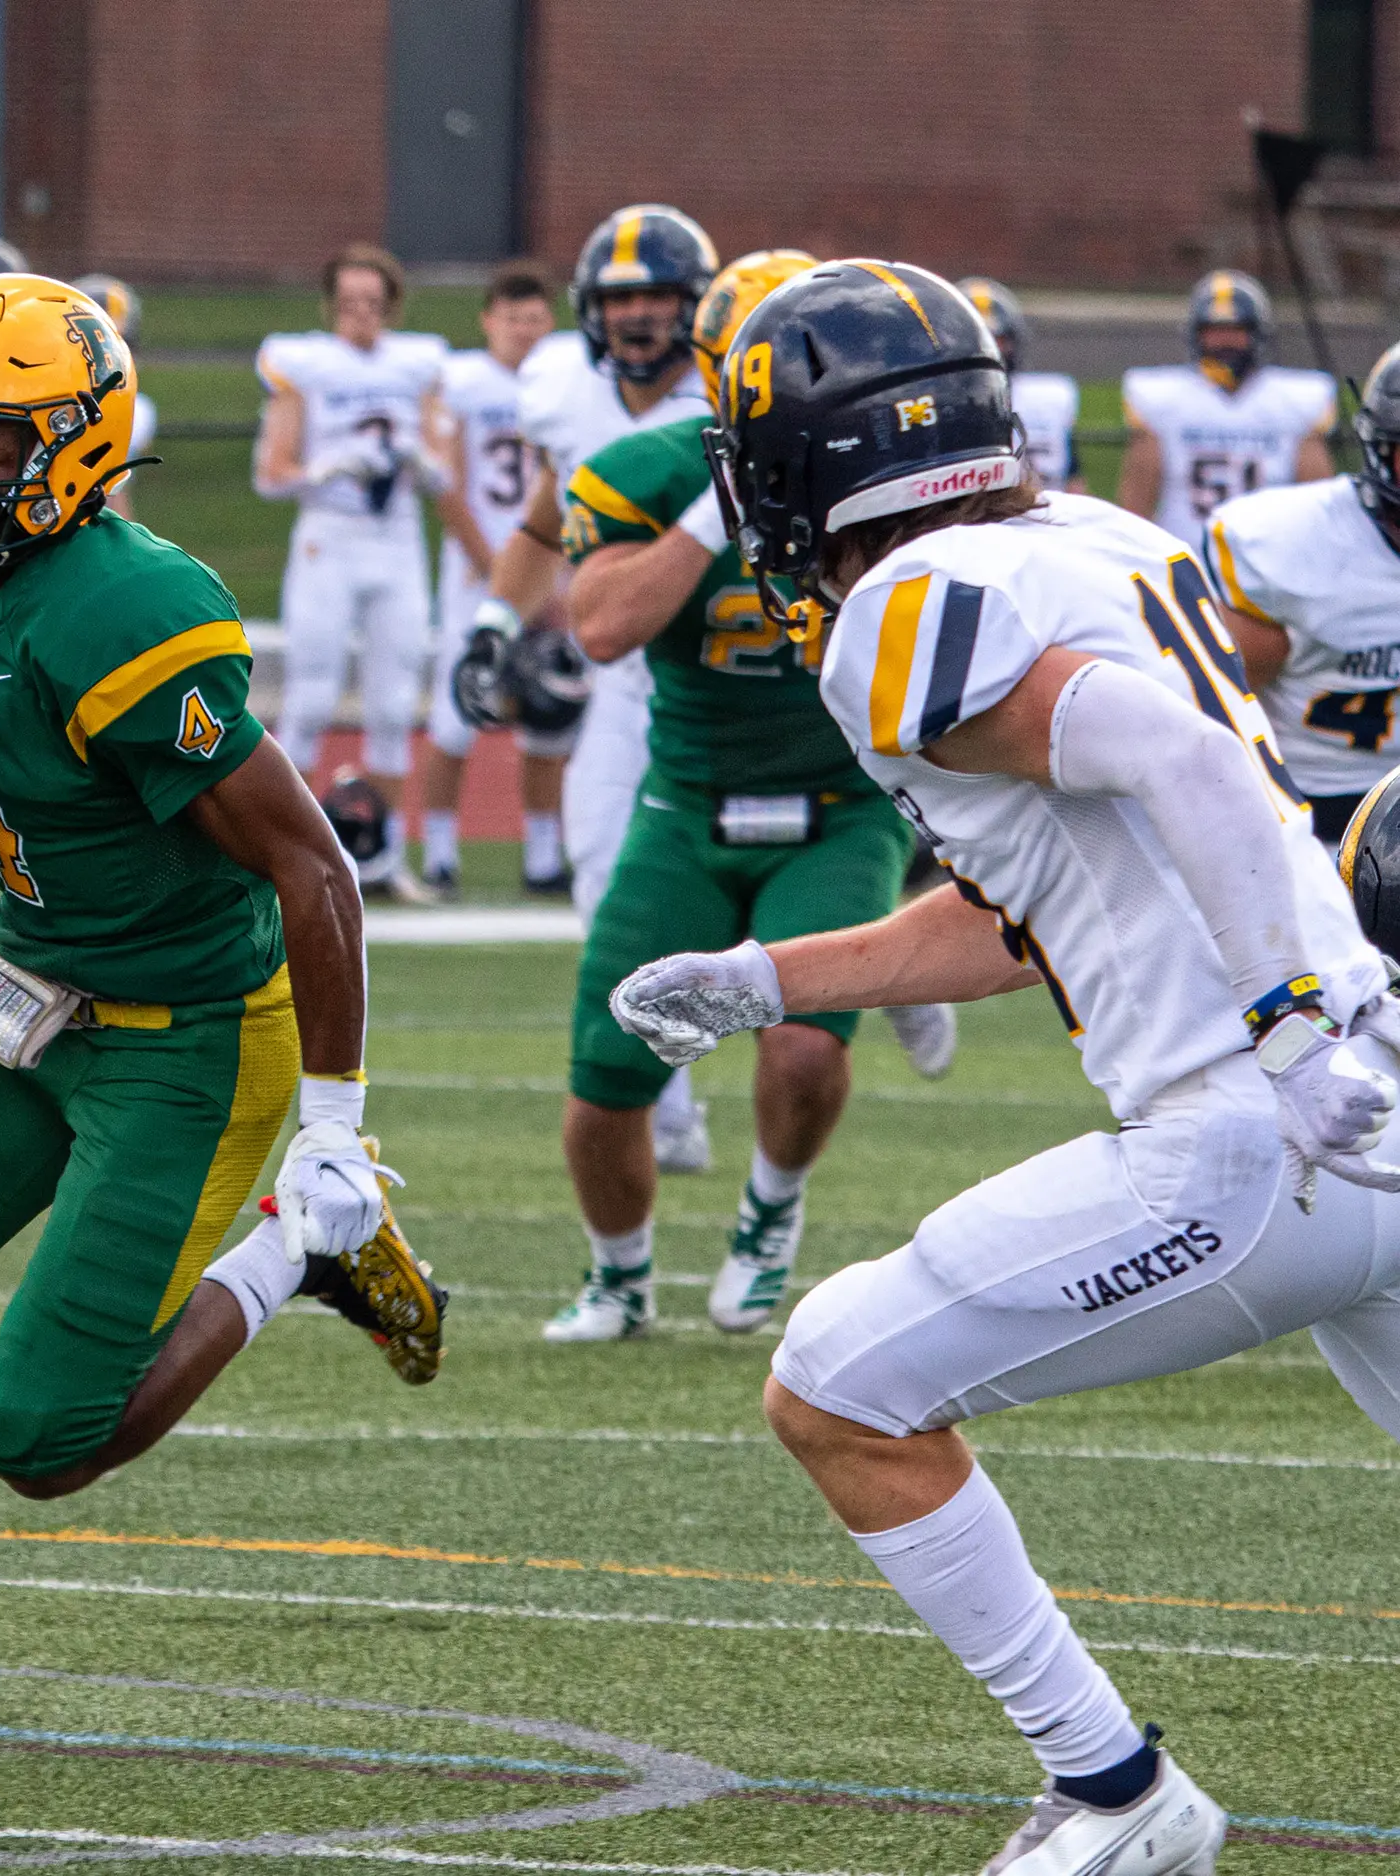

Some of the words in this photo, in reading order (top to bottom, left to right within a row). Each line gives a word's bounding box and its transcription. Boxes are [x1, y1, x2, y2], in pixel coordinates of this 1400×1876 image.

[729, 342, 773, 425] 19
[175, 687, 225, 759] 4
[1303, 687, 1396, 753] 4
